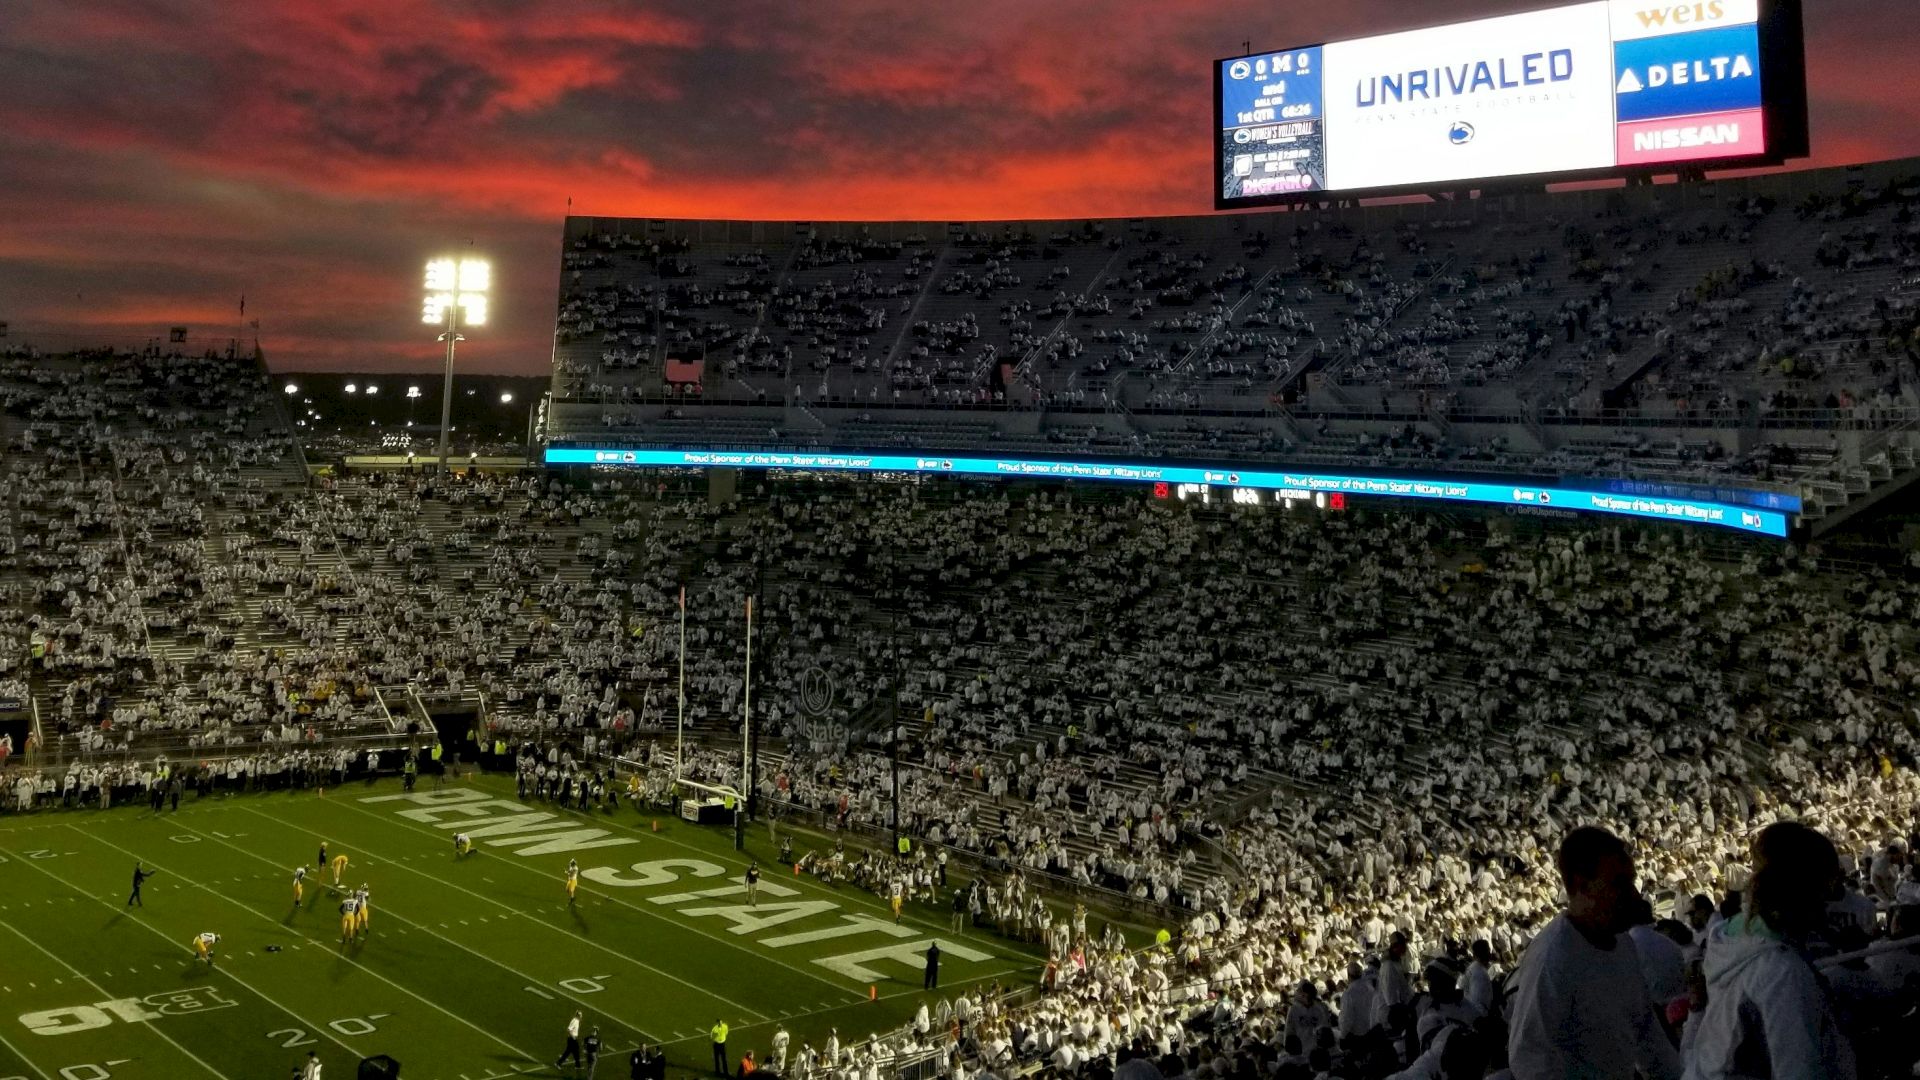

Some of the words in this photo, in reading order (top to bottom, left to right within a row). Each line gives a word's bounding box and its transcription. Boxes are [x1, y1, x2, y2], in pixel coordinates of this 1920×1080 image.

[1635, 0, 1724, 29] weis
[1255, 59, 1266, 75] 0
[1272, 54, 1291, 74] M
[1298, 53, 1308, 68] 0
[1648, 54, 1752, 87] DELTA
[1356, 48, 1573, 108] UNRIVALED
[1237, 112, 1253, 124] 1st
[1253, 108, 1275, 122] QTR
[1409, 104, 1462, 117] STATE
[1475, 91, 1577, 109] FOOTBALL
[1251, 126, 1278, 141] WOMEN'S
[1278, 121, 1313, 138] VOLLEYBALL
[1634, 123, 1739, 151] NISSAN
[685, 452, 709, 463] Proud
[710, 453, 742, 465] Sponsor
[745, 454, 755, 463] of
[755, 455, 769, 464] the
[770, 455, 791, 464] Penn
[817, 457, 847, 468] Nittany
[997, 462, 1019, 472] Proud
[1021, 463, 1050, 474] Sponsor
[1052, 463, 1061, 473] of
[1061, 464, 1073, 473] the
[1073, 465, 1092, 475] Penn
[1114, 468, 1140, 479] Nittany
[1284, 475, 1307, 487] Proud
[1308, 477, 1340, 489] Sponsor
[1342, 478, 1351, 489] of
[1352, 480, 1366, 490] the
[1367, 481, 1388, 492] Penn
[1414, 483, 1444, 497] Nittany
[1591, 495, 1608, 509] Proud
[1608, 497, 1632, 511] Sponsor
[1632, 498, 1639, 510] of
[1639, 501, 1650, 512] the
[1650, 501, 1666, 513] Penn
[1684, 505, 1709, 521] Nittany
[356, 787, 640, 857] PENN
[580, 858, 995, 983] STATE
[265, 1016, 377, 1049] 20
